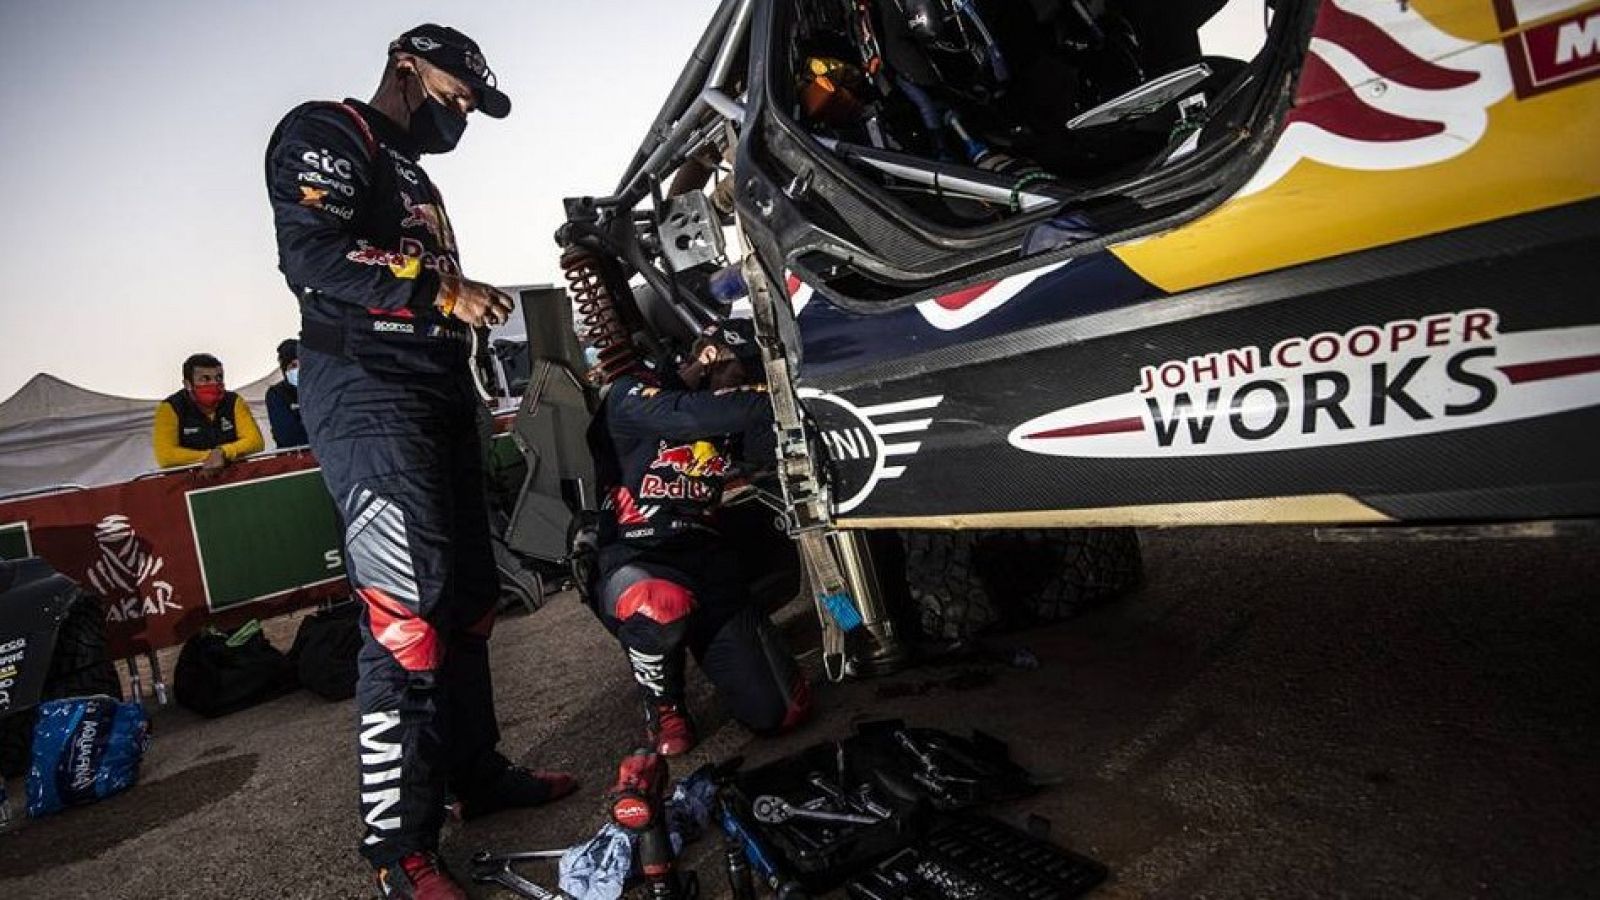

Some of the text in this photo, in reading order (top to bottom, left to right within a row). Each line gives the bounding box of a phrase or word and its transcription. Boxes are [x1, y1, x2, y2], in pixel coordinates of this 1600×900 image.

[1141, 312, 1493, 393] JOHN COOPER
[820, 397, 870, 460] INI
[1145, 346, 1498, 447] WORKS
[106, 581, 183, 622] AKAR
